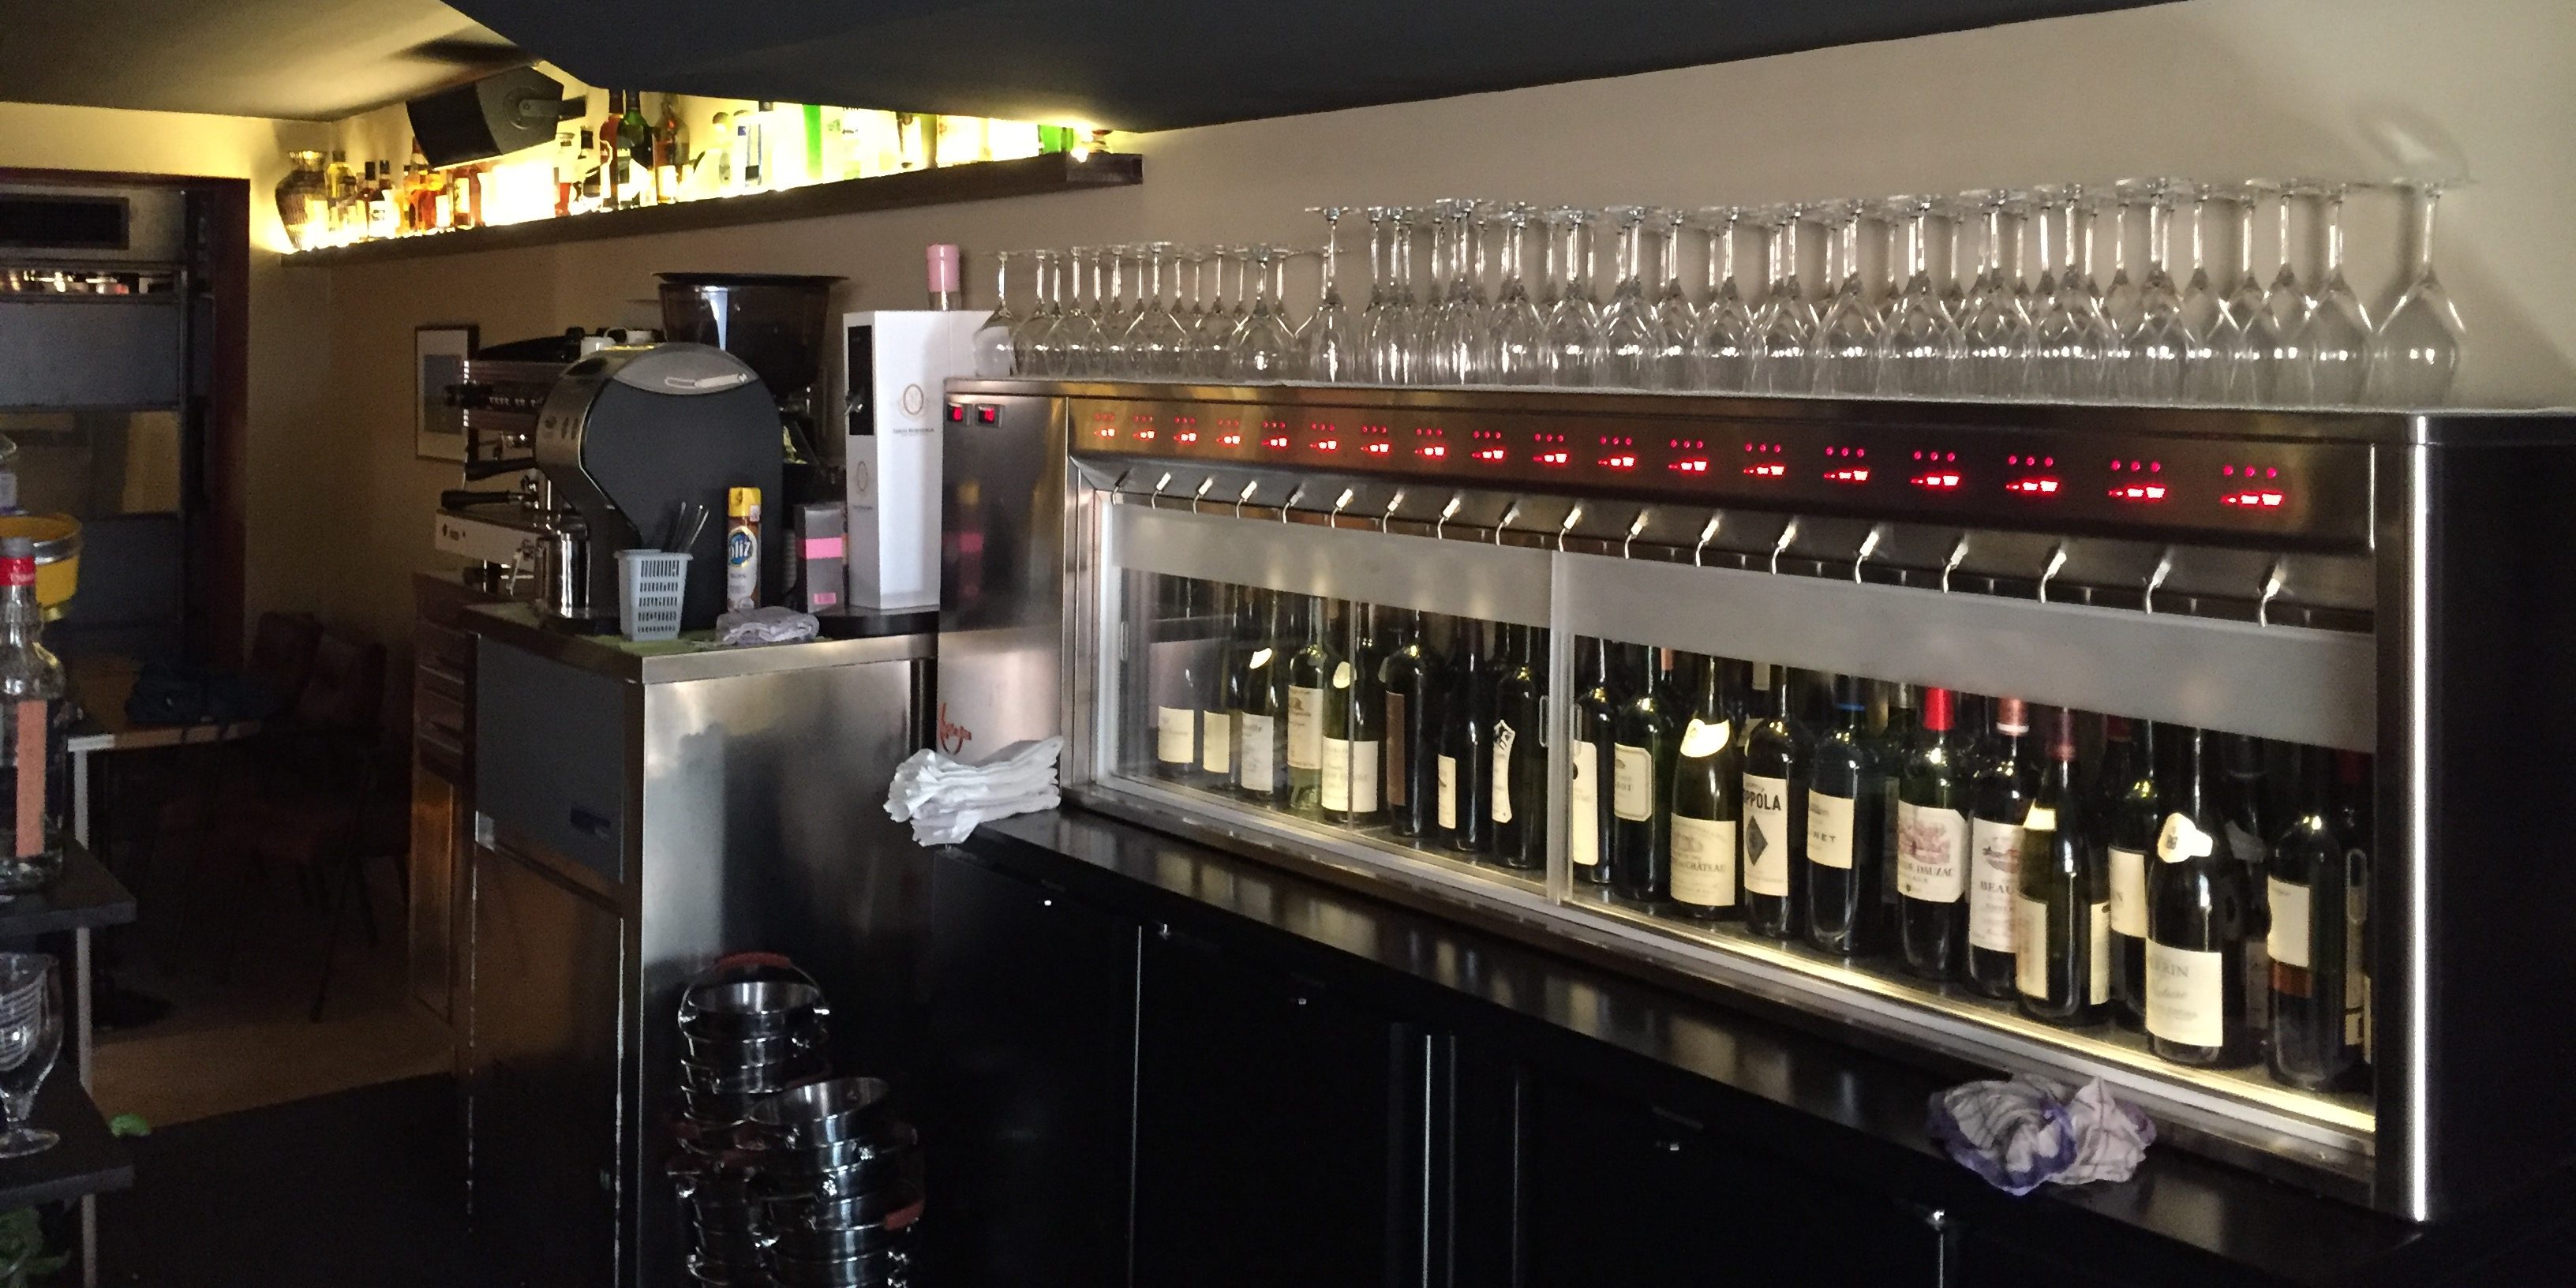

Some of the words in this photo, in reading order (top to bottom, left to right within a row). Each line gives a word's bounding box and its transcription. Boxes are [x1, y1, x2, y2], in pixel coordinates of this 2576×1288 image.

[1743, 788, 1781, 811] PPOLA
[1812, 831, 1837, 843] NET
[1980, 881, 2013, 894] BEAU
